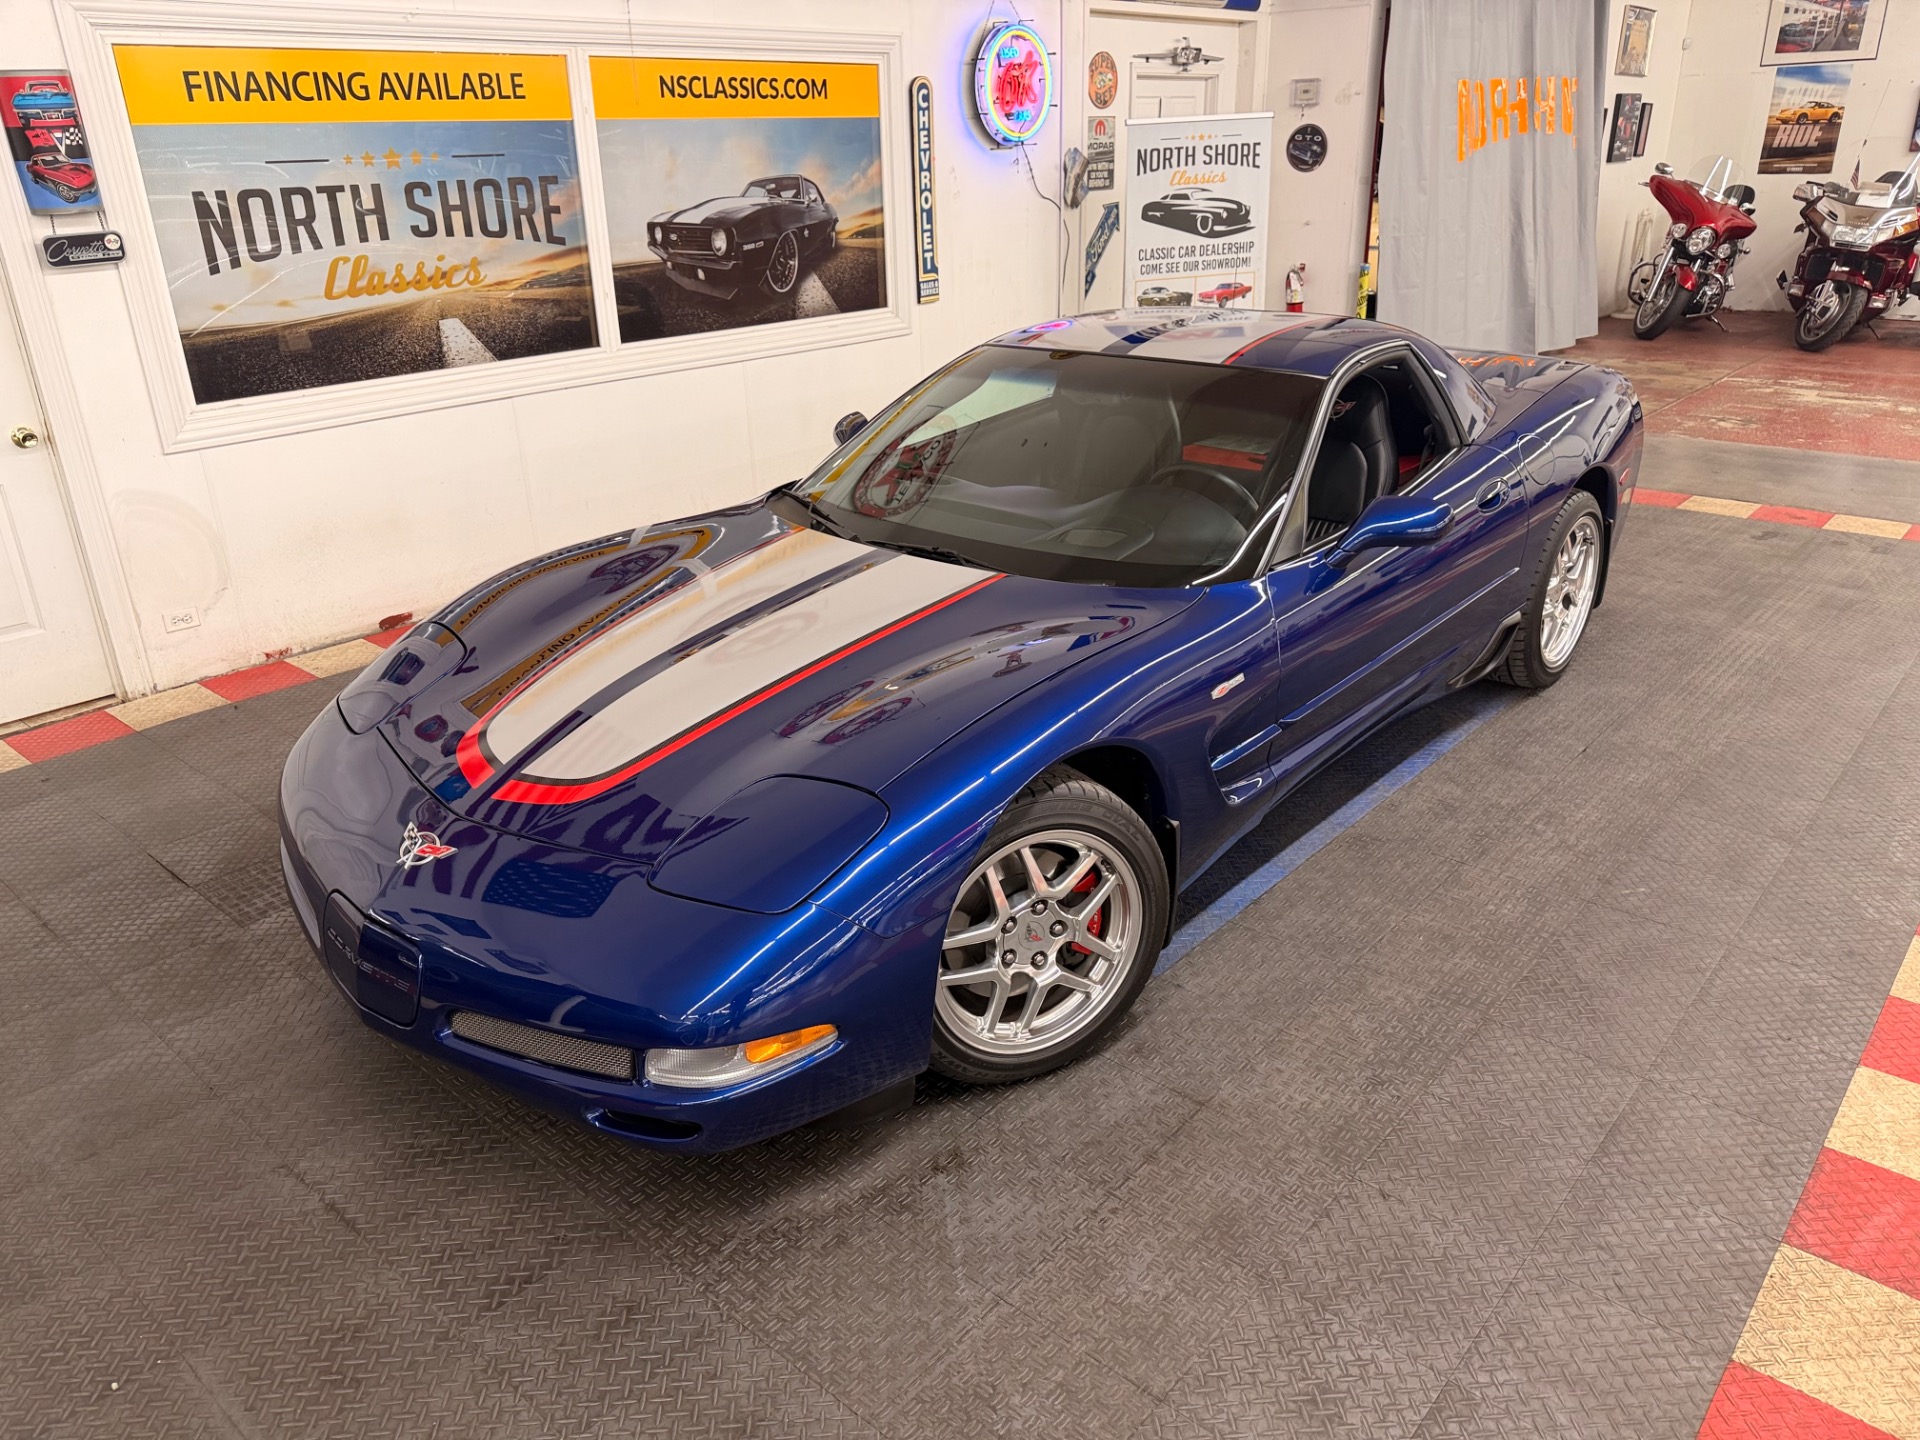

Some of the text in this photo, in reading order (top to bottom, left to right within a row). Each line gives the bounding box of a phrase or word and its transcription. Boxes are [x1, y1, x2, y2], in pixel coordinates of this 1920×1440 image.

[182, 70, 527, 103] FINANCING AVAILABLE
[658, 75, 828, 100] NSCLASSICS.COM
[1094, 86, 1114, 106] BEE
[1294, 133, 1322, 142] GTO
[1772, 124, 1823, 149] RIDE
[1136, 142, 1261, 177] NORTH SHORE
[918, 87, 934, 270] CHEVROLET
[1169, 170, 1228, 187] Classics
[191, 175, 567, 277] NORTH SHORE
[47, 239, 107, 263] Corvette
[1138, 240, 1255, 262] CLASSIC CAR DEALERSHIP
[323, 252, 488, 301] Classics
[1140, 256, 1252, 276] COME SEE OUR SHOWROOM!
[327, 927, 410, 993] CORVETTE
